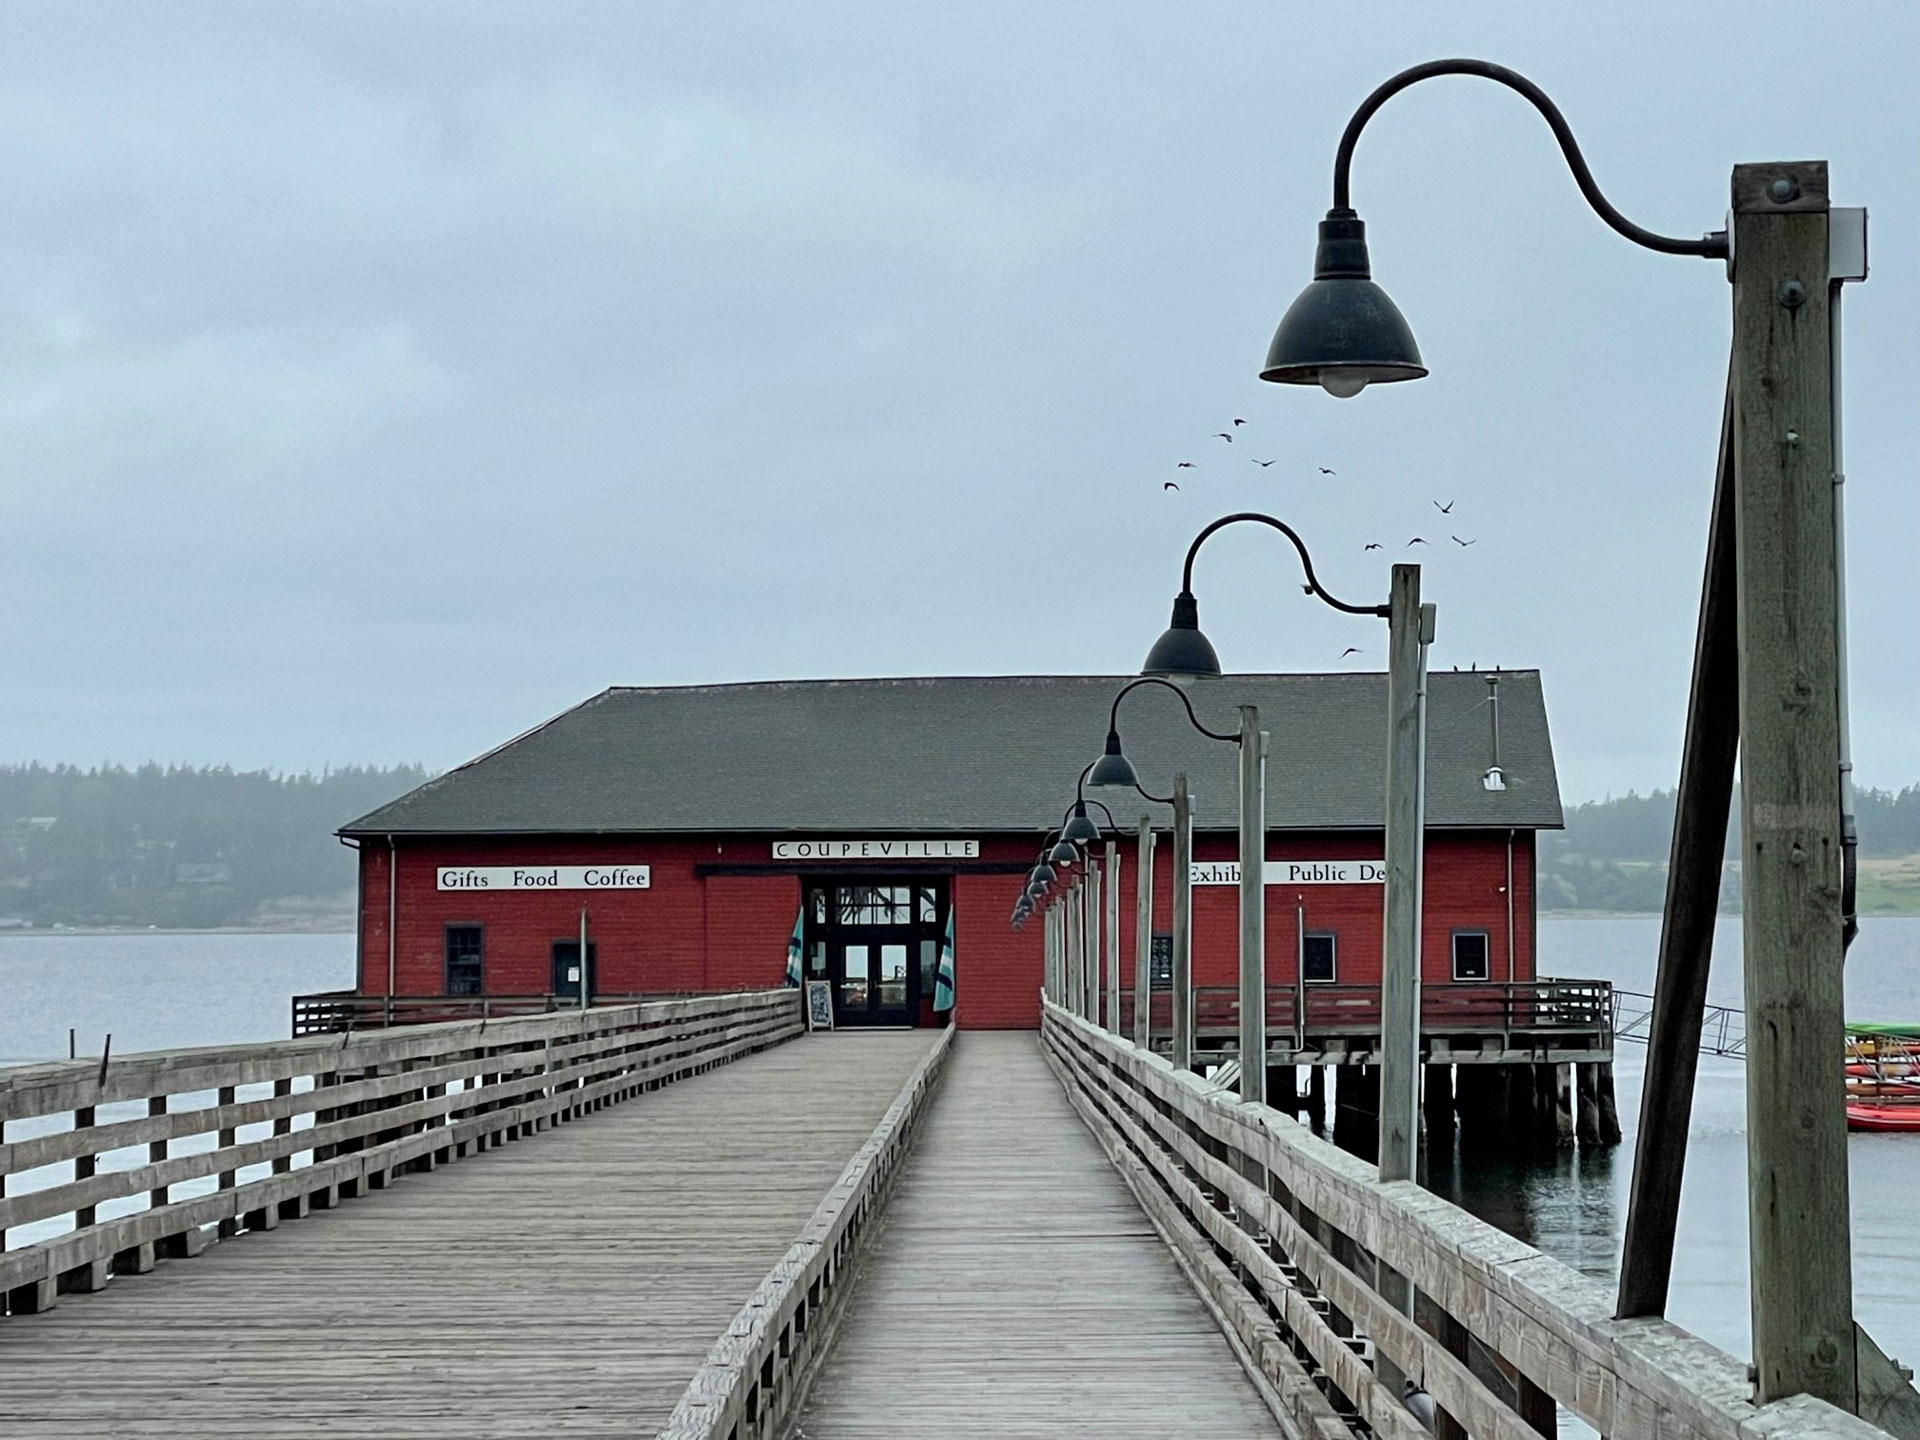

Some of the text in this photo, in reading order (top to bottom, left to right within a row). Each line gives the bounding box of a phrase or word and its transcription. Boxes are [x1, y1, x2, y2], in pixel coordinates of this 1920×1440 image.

[776, 842, 973, 857] COUPEVILLE
[442, 868, 646, 888] Gifts Food Coffee
[1190, 864, 1386, 882] Exhib Public De
